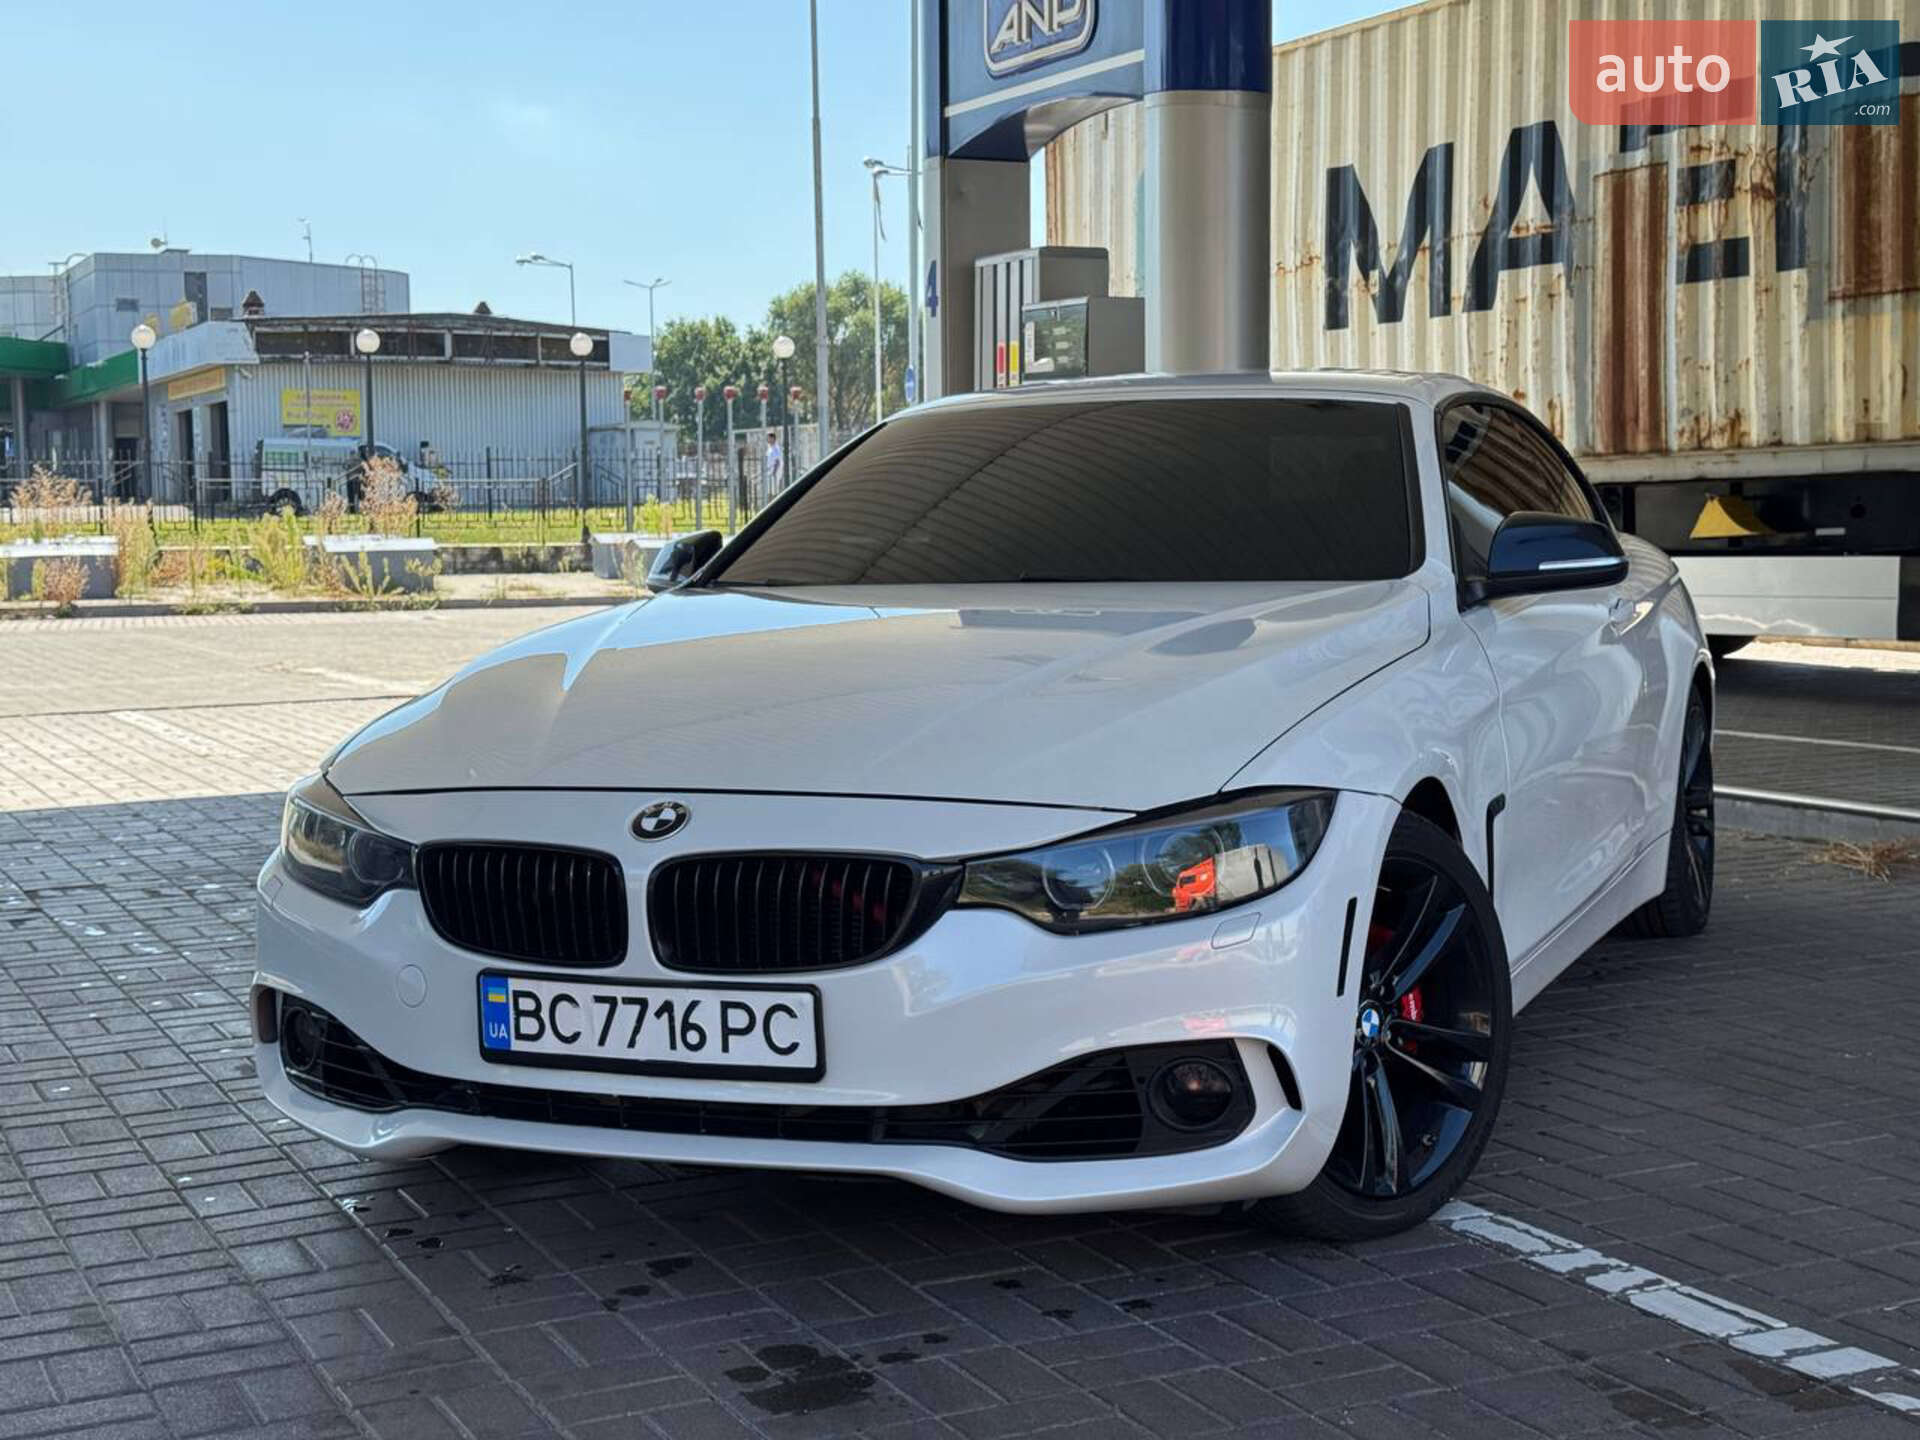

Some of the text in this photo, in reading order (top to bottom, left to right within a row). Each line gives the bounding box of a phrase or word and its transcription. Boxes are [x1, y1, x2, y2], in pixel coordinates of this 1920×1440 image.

[925, 260, 938, 317] 4
[488, 1021, 508, 1039] UA
[512, 989, 800, 1055] BC 7716 PC
